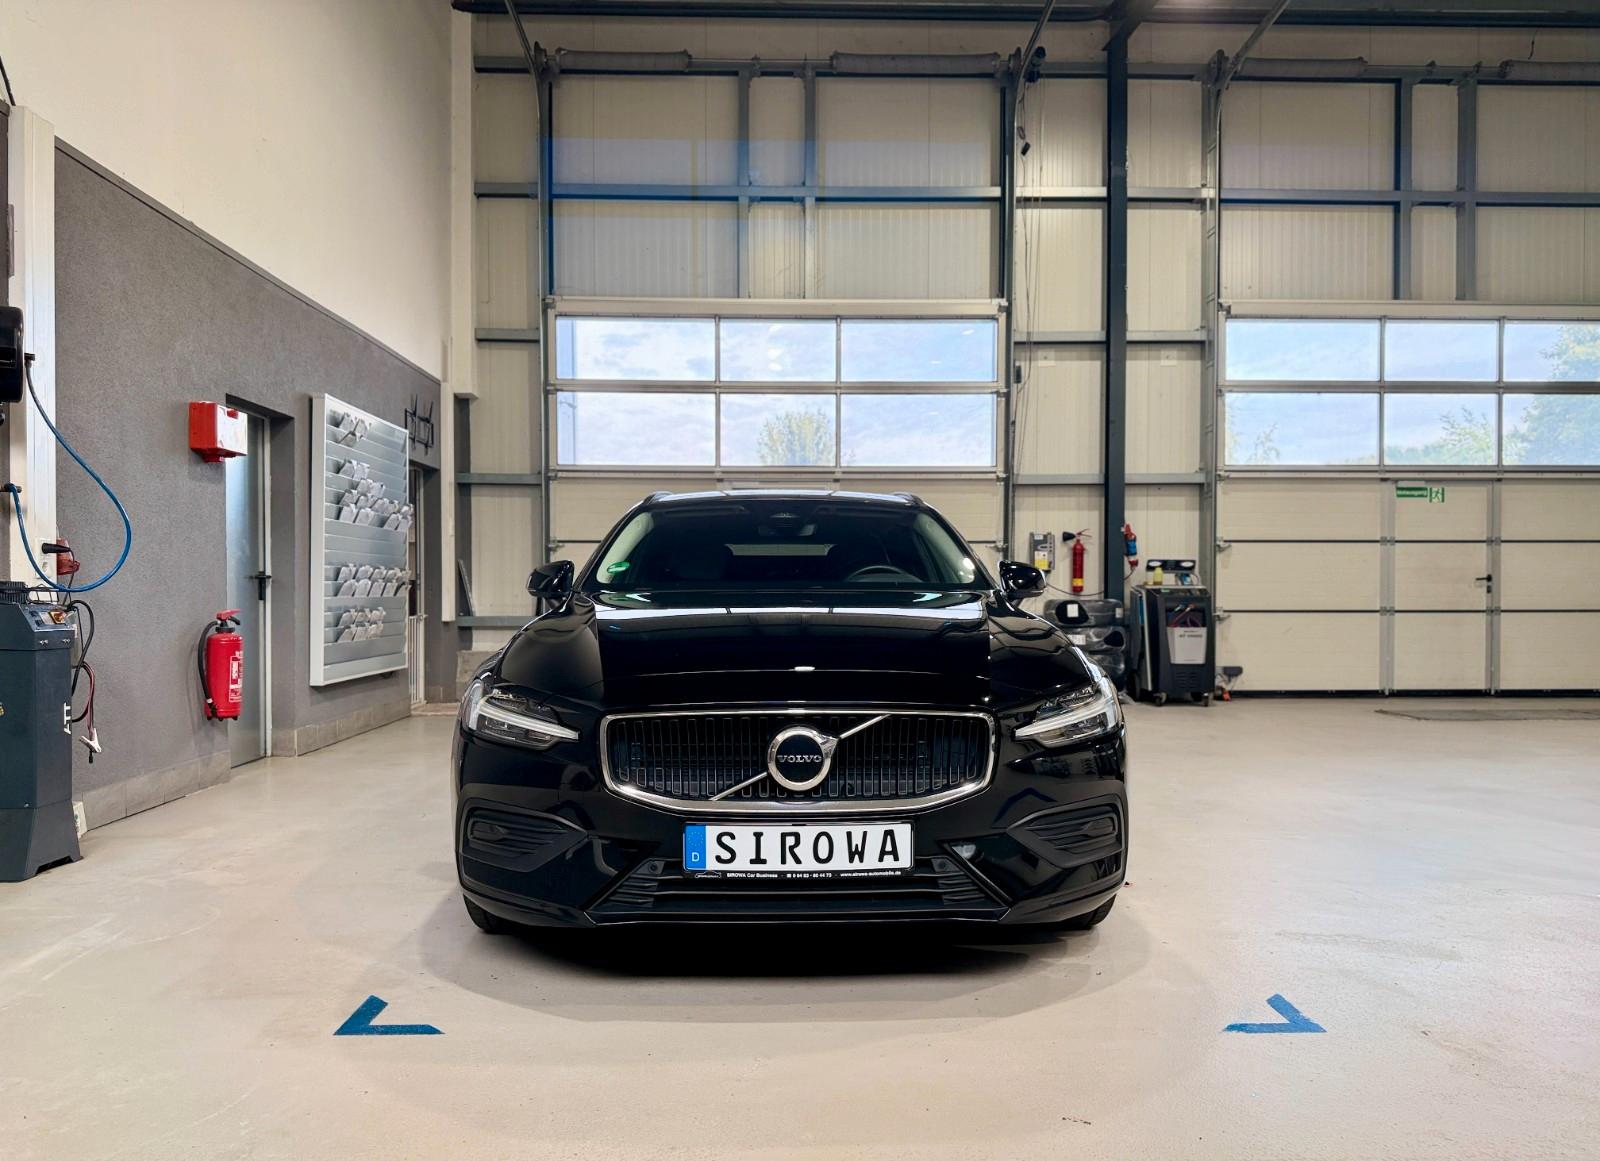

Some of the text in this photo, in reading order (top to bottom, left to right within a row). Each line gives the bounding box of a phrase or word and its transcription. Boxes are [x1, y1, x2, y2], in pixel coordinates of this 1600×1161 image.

[776, 754, 823, 763] VOLVO
[714, 829, 900, 866] SIROWA
[691, 852, 700, 862] D
